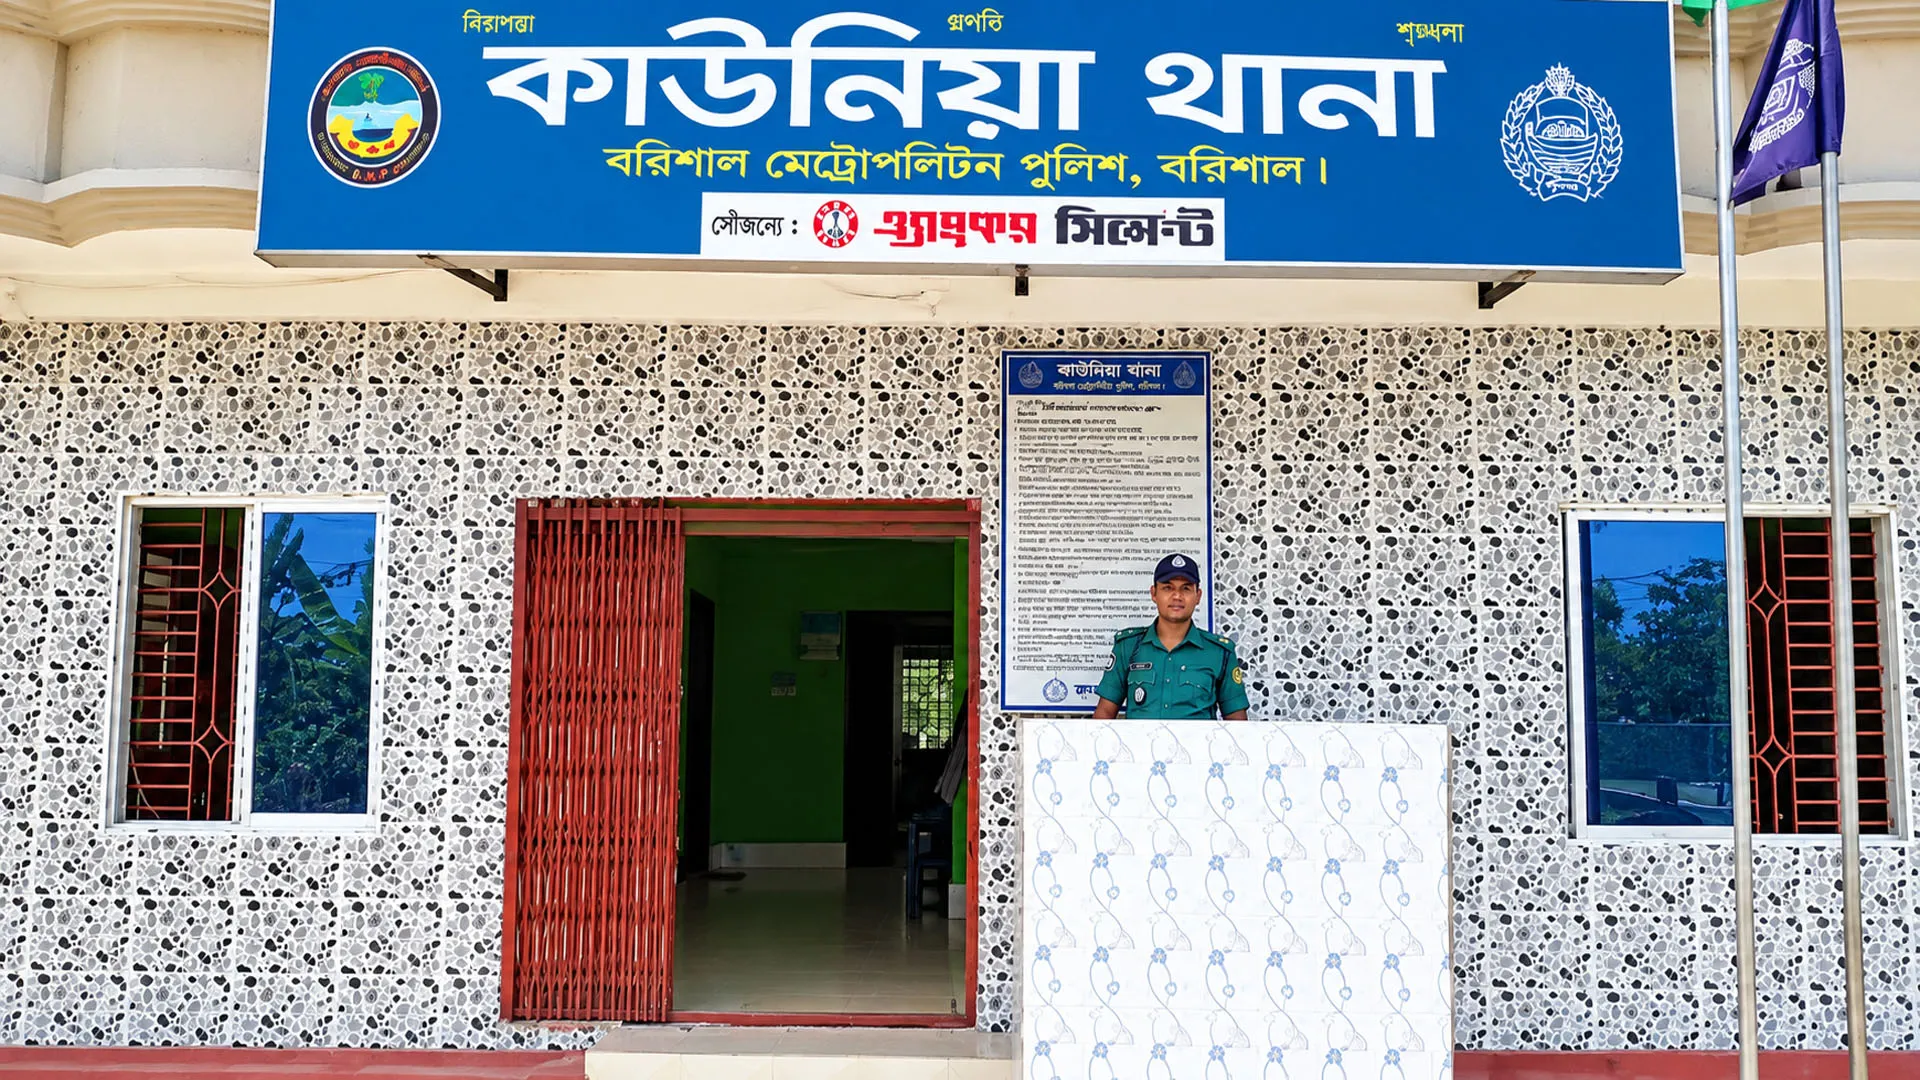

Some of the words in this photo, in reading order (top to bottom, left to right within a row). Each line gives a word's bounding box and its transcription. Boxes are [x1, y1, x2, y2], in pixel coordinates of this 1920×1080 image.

[483, 12, 1095, 140] কাউনিয়া
[1145, 52, 1447, 138] থানা
[603, 139, 750, 178] বরিশাল
[765, 140, 1004, 184] মেট্রোপলিটন
[1020, 142, 1141, 190] পুলিশ,
